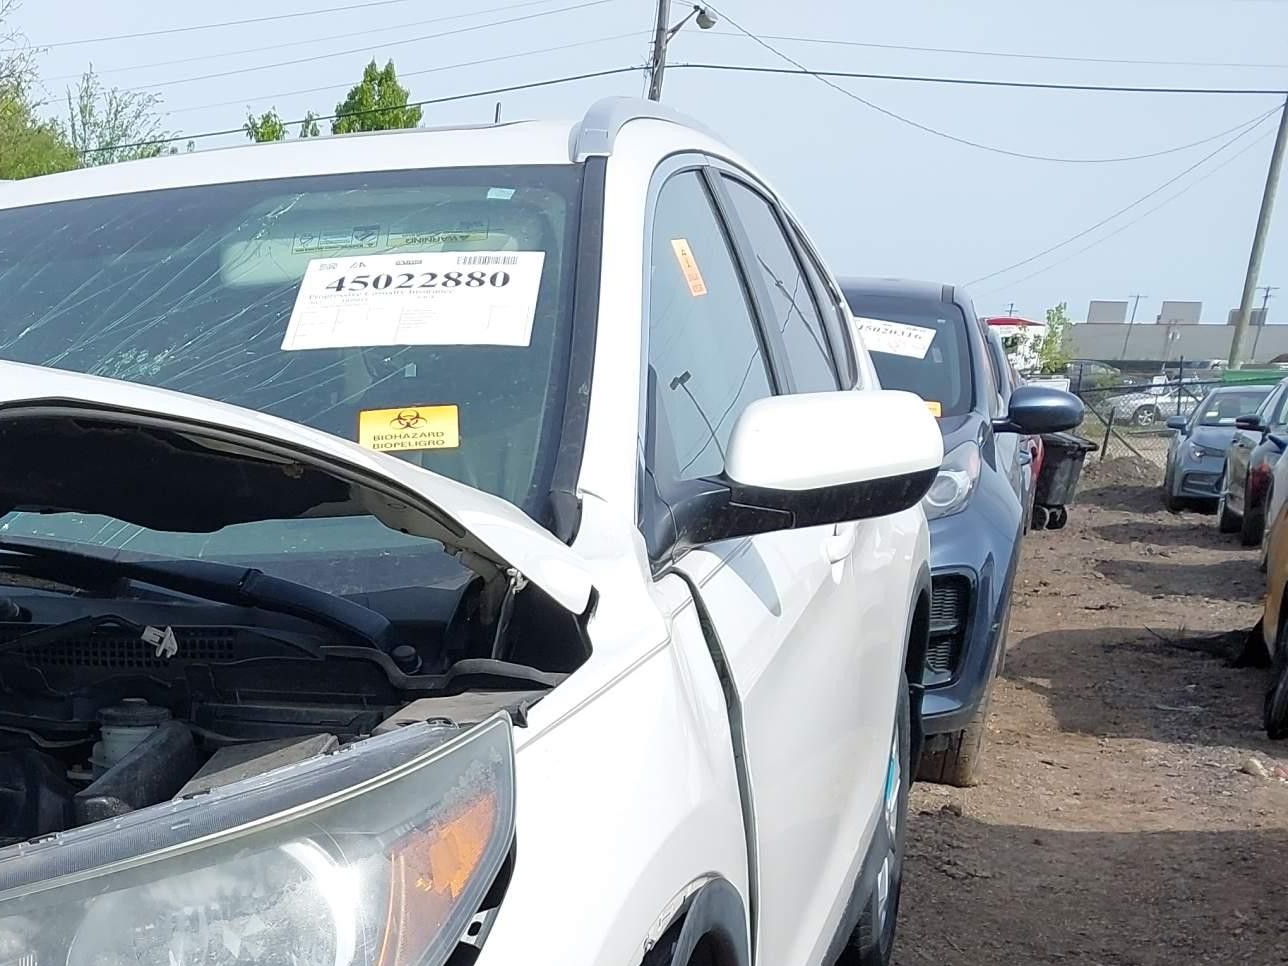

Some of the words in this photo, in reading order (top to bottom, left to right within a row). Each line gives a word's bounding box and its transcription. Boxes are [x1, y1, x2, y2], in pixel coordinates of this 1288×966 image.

[405, 235, 458, 245] WARNING
[325, 270, 511, 292] 45022880
[373, 431, 445, 441] BIOHAZARD
[372, 440, 446, 449] BIOPELIGRO
